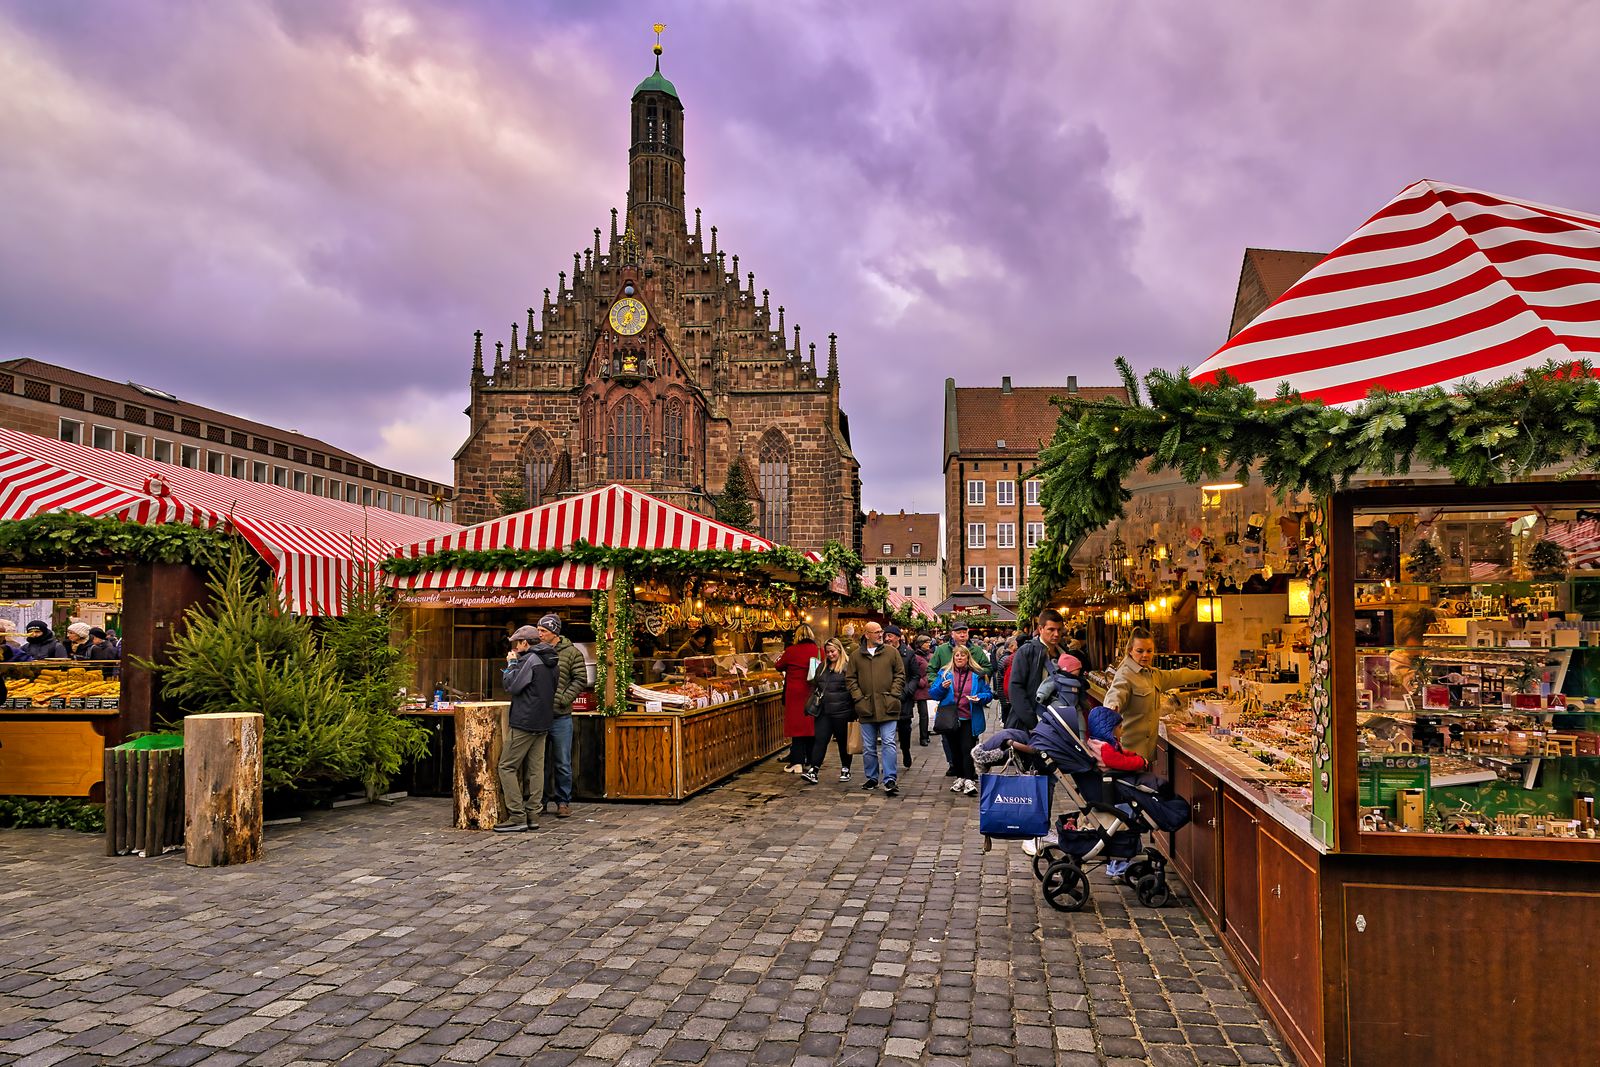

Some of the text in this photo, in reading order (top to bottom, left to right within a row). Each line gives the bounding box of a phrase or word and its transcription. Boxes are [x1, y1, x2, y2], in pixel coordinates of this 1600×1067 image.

[517, 589, 576, 599] Kokosmakronen
[446, 594, 516, 606] Marzipankartoffeln
[994, 794, 1033, 804] ANSON'S
